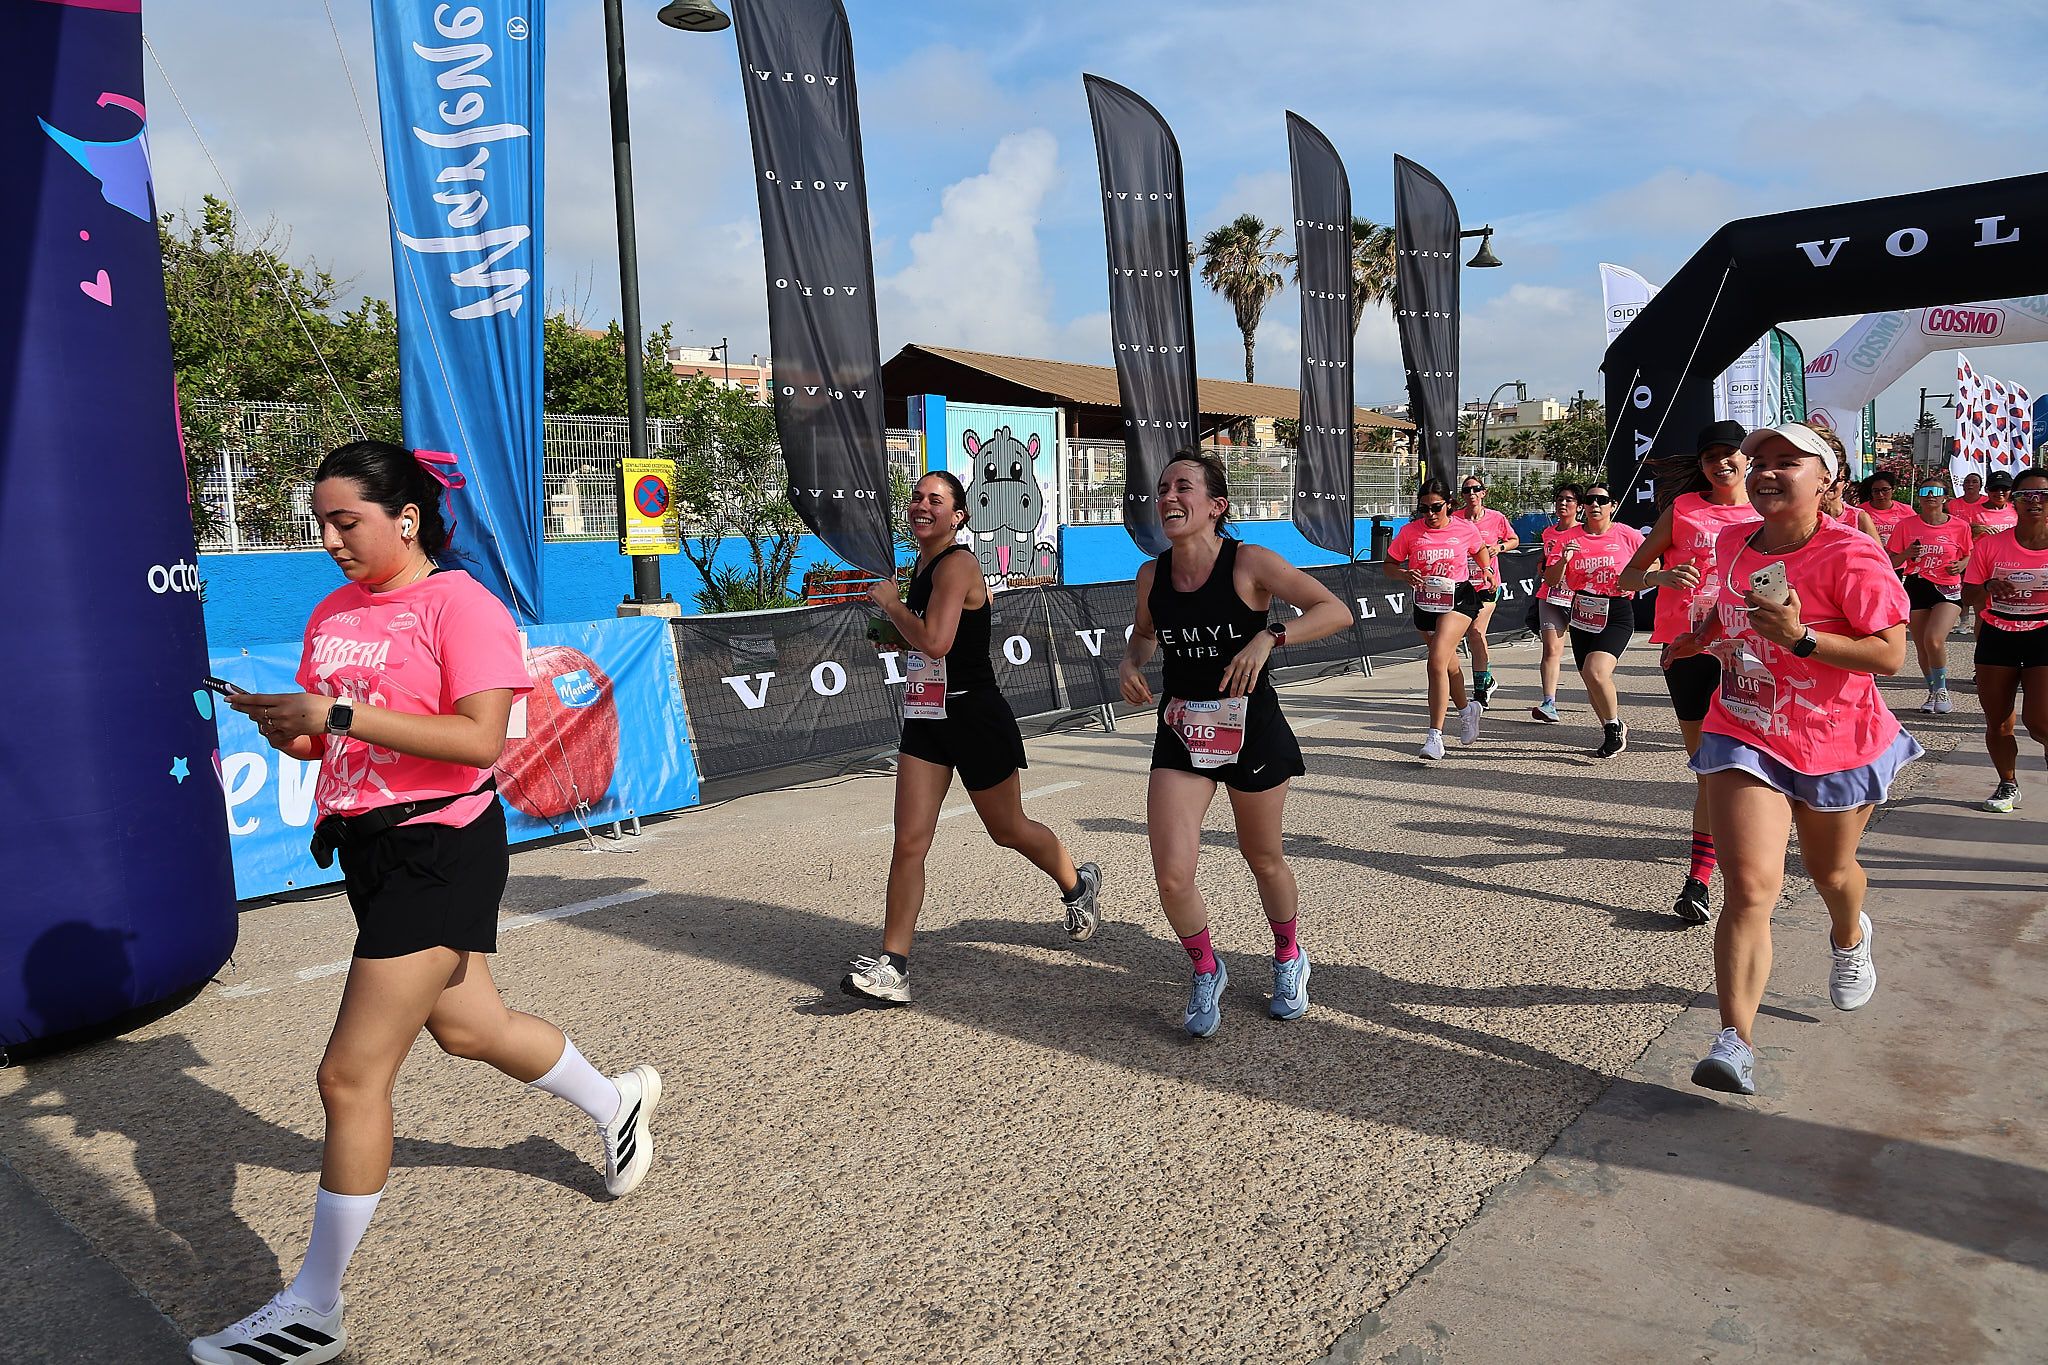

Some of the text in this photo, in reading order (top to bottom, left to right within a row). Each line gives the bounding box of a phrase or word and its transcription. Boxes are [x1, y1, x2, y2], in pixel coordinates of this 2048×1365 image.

[1929, 309, 1998, 334] COSMO
[1417, 549, 1455, 560] CARRERA
[1574, 556, 1615, 570] CARRERA
[148, 559, 201, 600] octo
[1579, 611, 1594, 619] 016
[1155, 623, 1242, 644] EMYL
[721, 635, 1032, 710] VOLO
[560, 679, 596, 702] Marlene
[905, 682, 925, 694] 016
[1738, 675, 1760, 693] 016
[1184, 725, 1216, 738] 016
